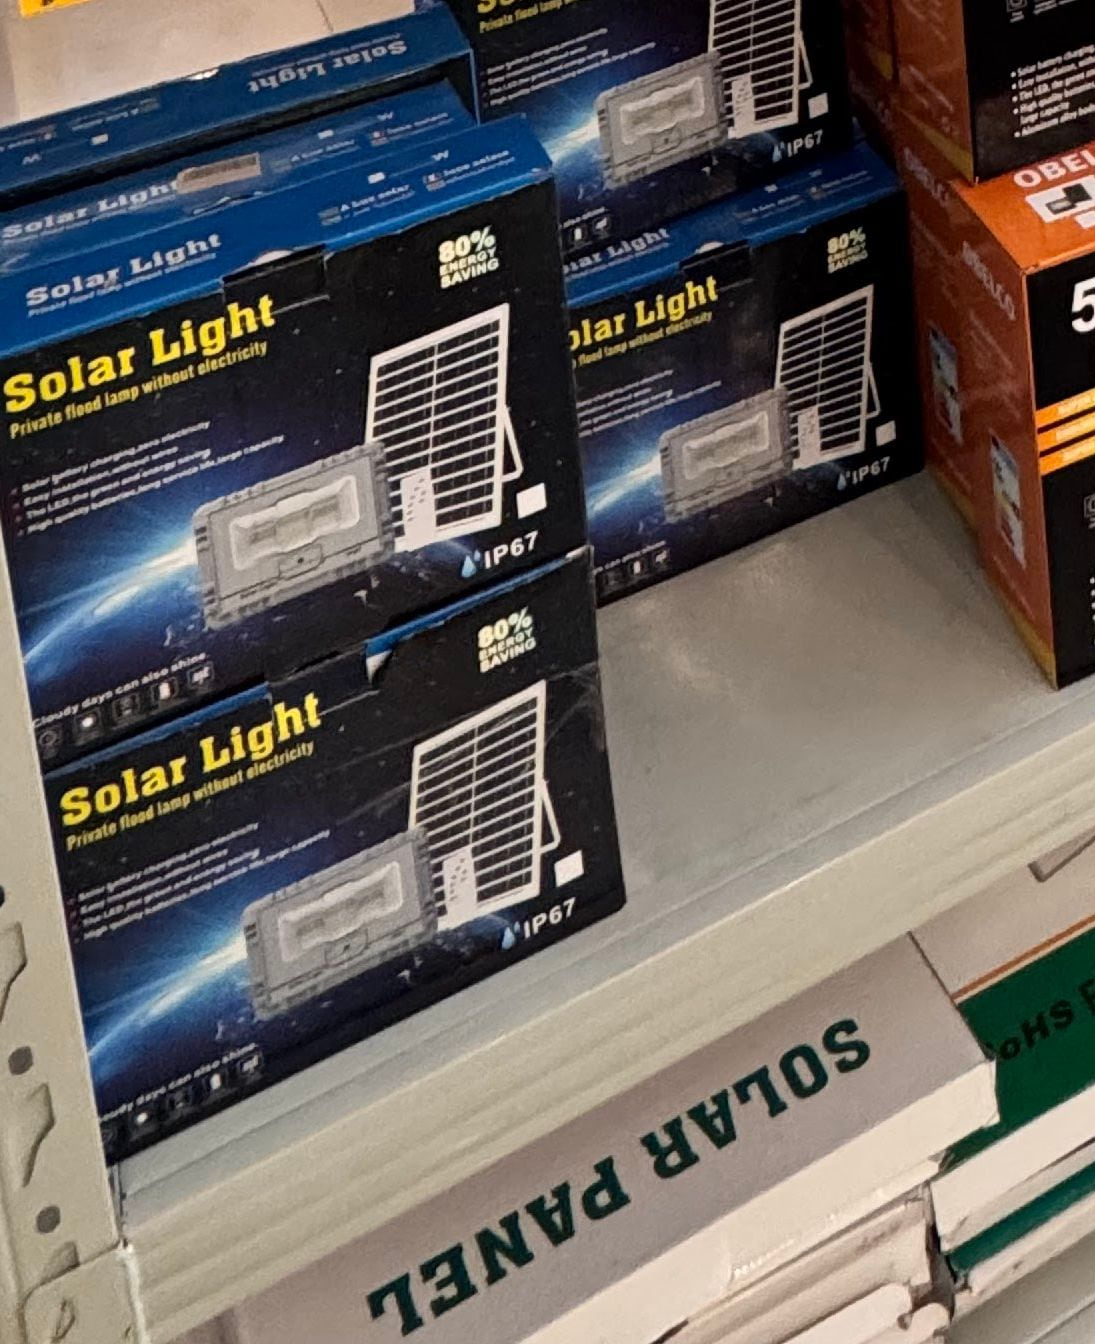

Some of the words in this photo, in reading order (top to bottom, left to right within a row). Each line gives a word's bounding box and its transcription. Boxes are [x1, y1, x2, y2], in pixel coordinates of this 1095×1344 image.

[786, 129, 826, 159] IP67
[25, 261, 122, 309] Solar
[128, 232, 222, 276] Light
[438, 225, 497, 263] 80%
[439, 248, 498, 278] ENERGY
[440, 259, 500, 291] SAVING
[567, 310, 626, 352] olar
[634, 273, 720, 330] Light
[3, 345, 137, 414] Solar
[149, 293, 276, 367] Light
[10, 409, 64, 440] Private
[65, 395, 102, 422] flood
[104, 381, 140, 409] lamp
[142, 365, 196, 395] without
[197, 339, 269, 376] electricity
[483, 529, 540, 571] IP67
[59, 754, 188, 827] Solar
[199, 691, 323, 775] Light
[522, 896, 578, 941] IP67
[986, 997, 1076, 1061] oHS
[639, 1017, 872, 1180] SOLAR
[366, 1155, 632, 1338] PANEL
